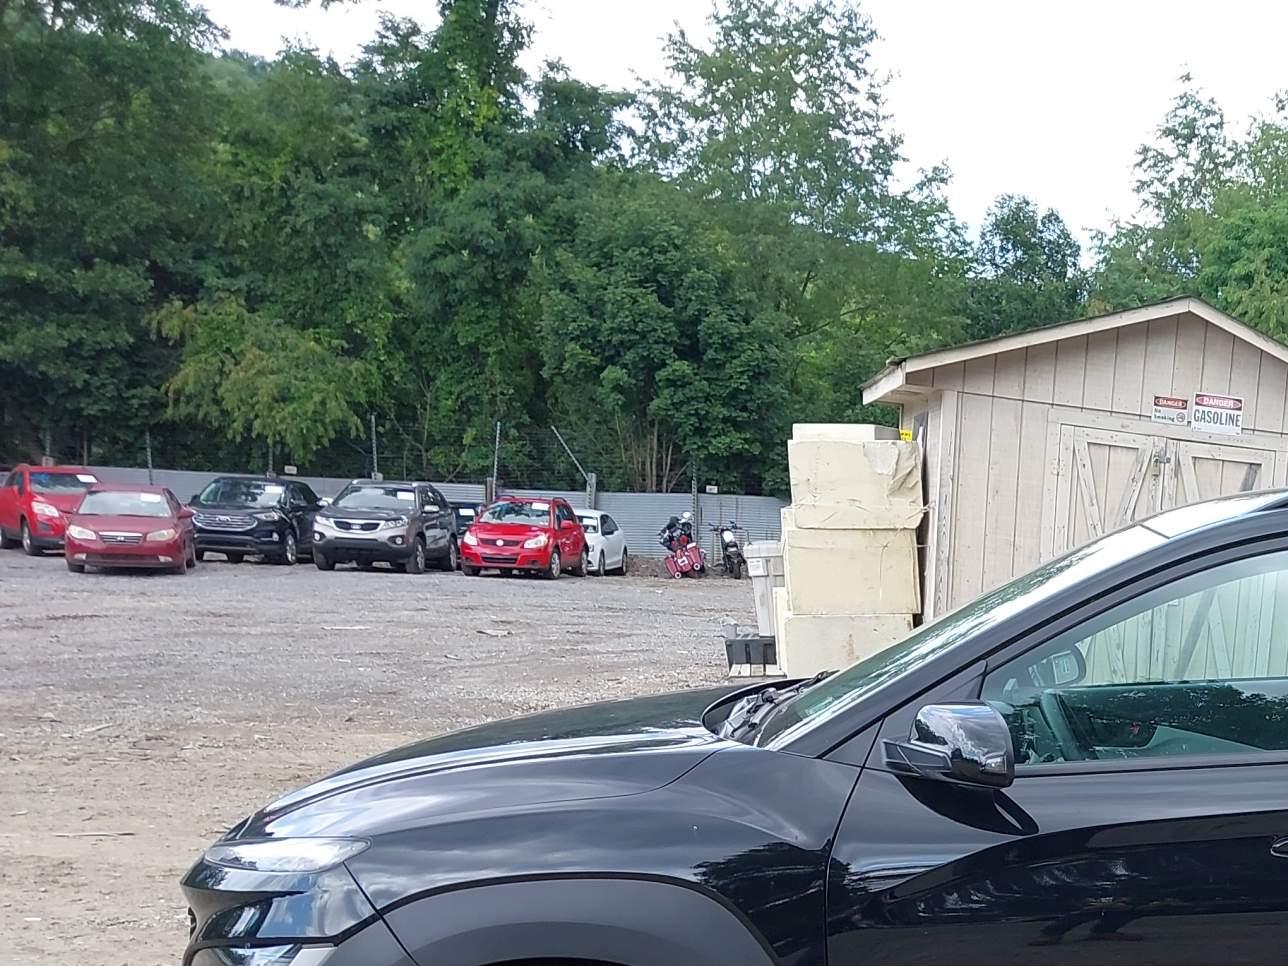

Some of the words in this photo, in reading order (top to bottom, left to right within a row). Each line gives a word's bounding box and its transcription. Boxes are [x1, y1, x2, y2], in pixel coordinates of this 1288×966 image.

[1160, 398, 1182, 408] DANGER
[1203, 396, 1234, 408] DANGER
[1193, 409, 1241, 427] GASOLINE
